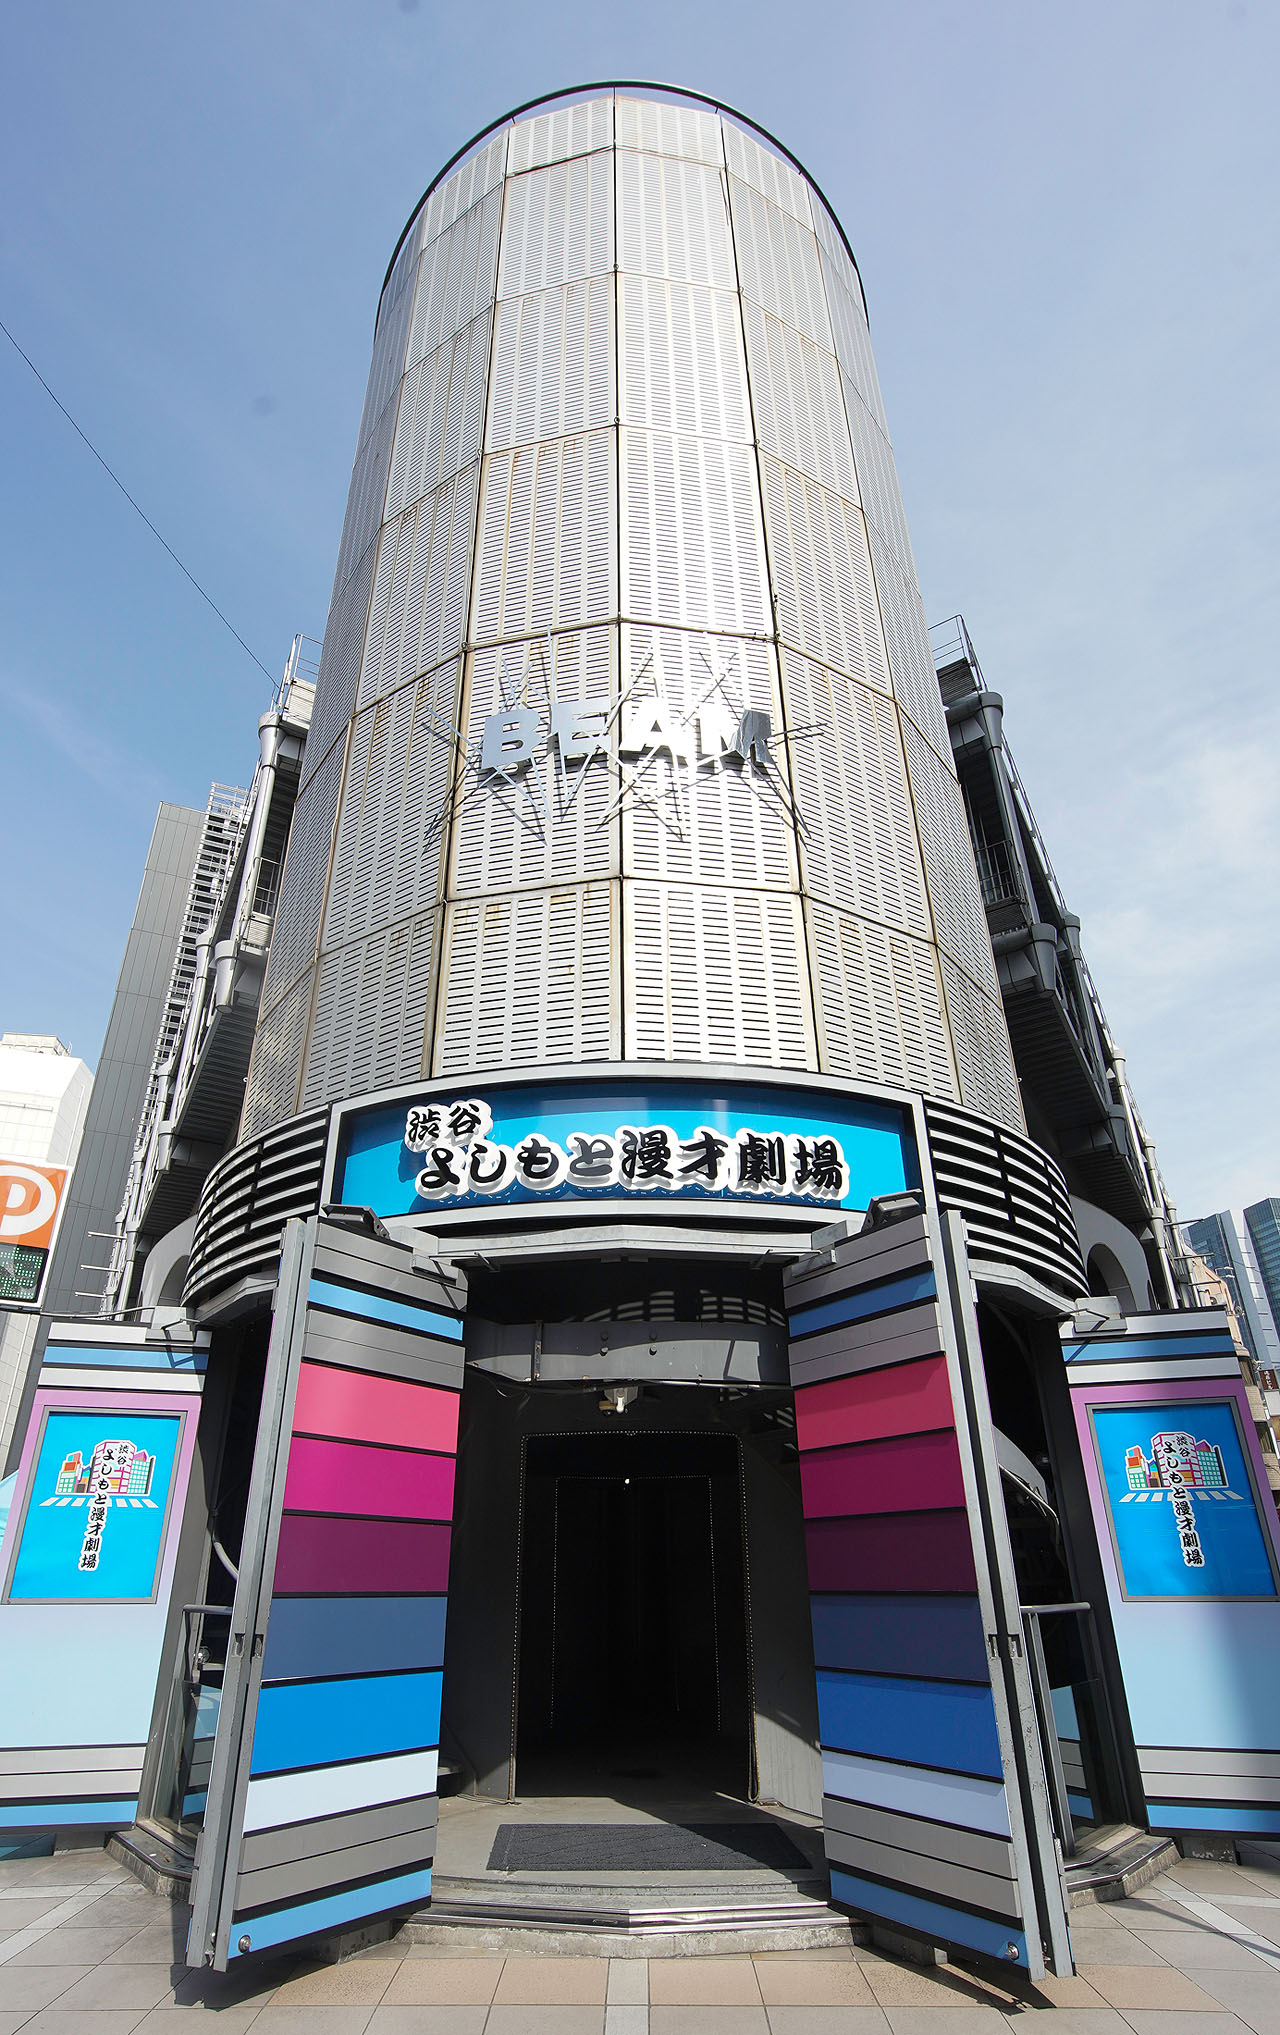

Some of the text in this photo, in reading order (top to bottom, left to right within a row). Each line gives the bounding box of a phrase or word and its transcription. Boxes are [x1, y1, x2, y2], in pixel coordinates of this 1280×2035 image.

[481, 700, 772, 770] BEAM
[408, 1103, 482, 1143] 渋谷
[420, 1130, 843, 1190] よしもと漫才劇場
[0, 1166, 56, 1236] P
[117, 1444, 129, 1466] 渋谷
[1175, 1435, 1191, 1457] 渋谷
[80, 1449, 115, 1569] よしもと漫才劇場
[1162, 1440, 1203, 1566] よしもと漫才劇場
